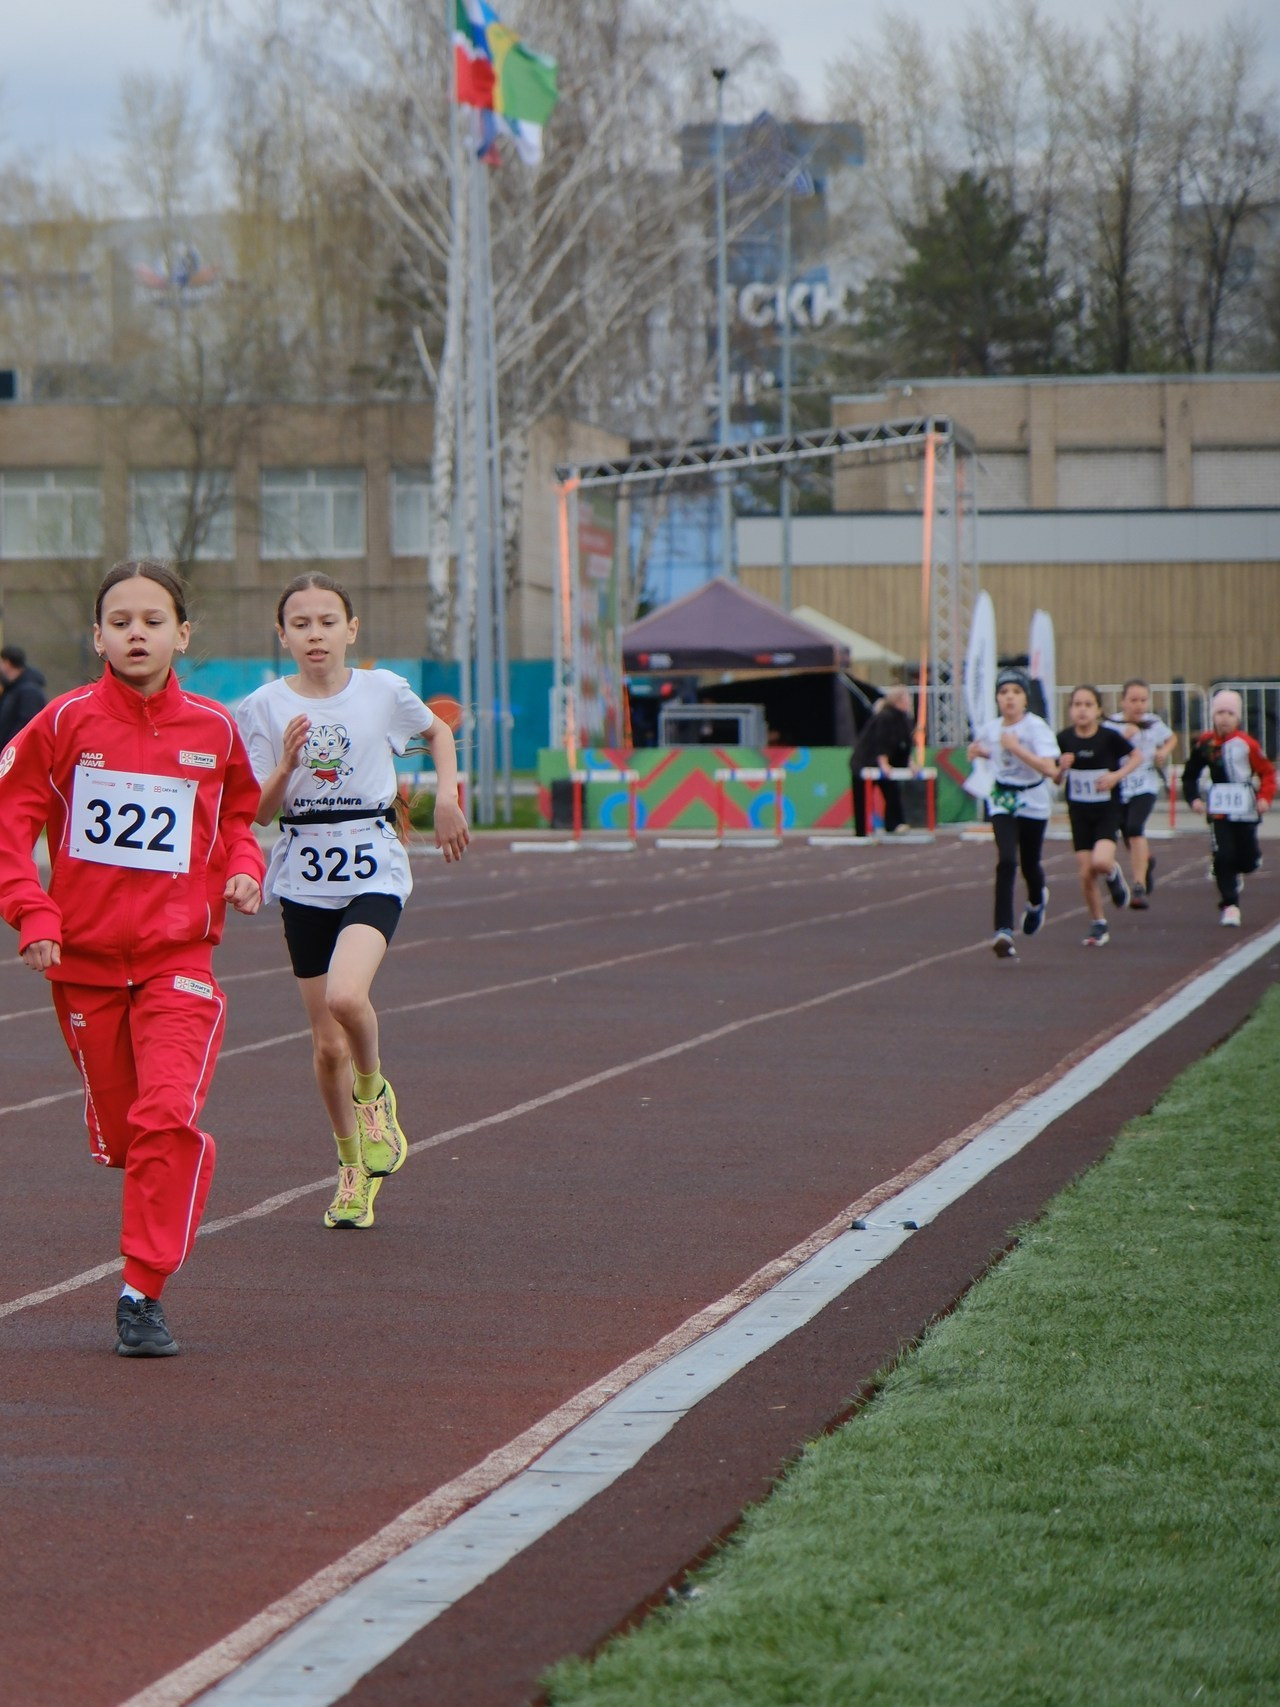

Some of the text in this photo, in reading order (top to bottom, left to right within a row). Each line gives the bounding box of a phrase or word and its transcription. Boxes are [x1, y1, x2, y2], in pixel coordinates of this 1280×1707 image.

[81, 752, 104, 761] MAD
[79, 758, 106, 768] WAVE
[293, 796, 363, 807] ДЕТСКАЯ ЛИГА
[85, 799, 176, 853] 322
[300, 842, 378, 882] 325
